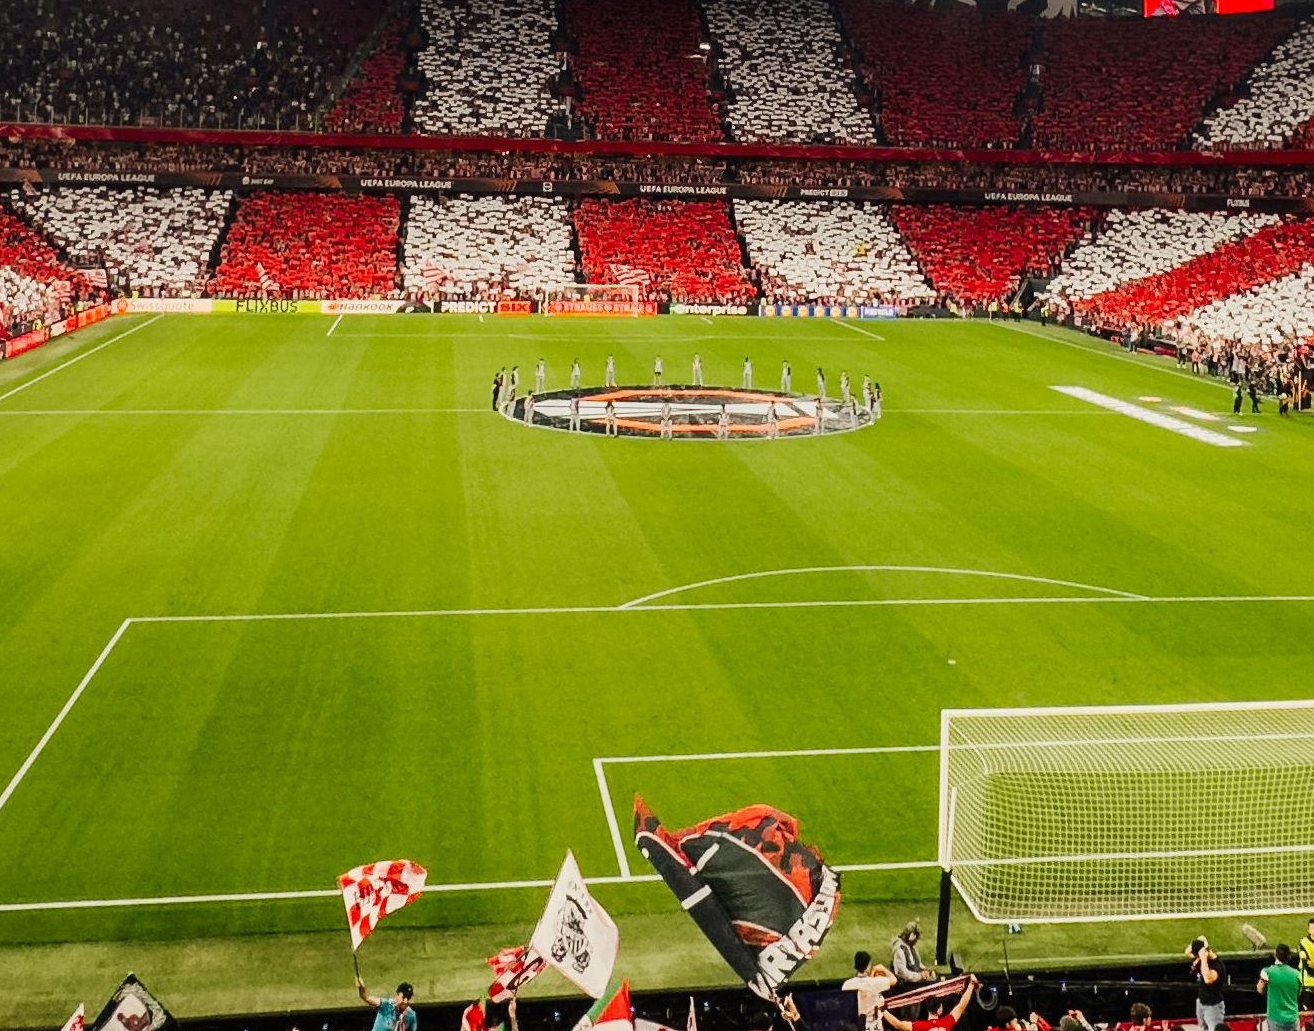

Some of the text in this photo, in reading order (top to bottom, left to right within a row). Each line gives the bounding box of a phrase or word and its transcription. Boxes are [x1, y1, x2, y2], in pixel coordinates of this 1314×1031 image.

[84, 173, 118, 181] EUROPA
[121, 174, 155, 182] LEAGUE
[1042, 194, 1072, 202] LEAGUE
[236, 300, 298, 313] FLIXBUS
[441, 301, 529, 313] PREDICT SIX
